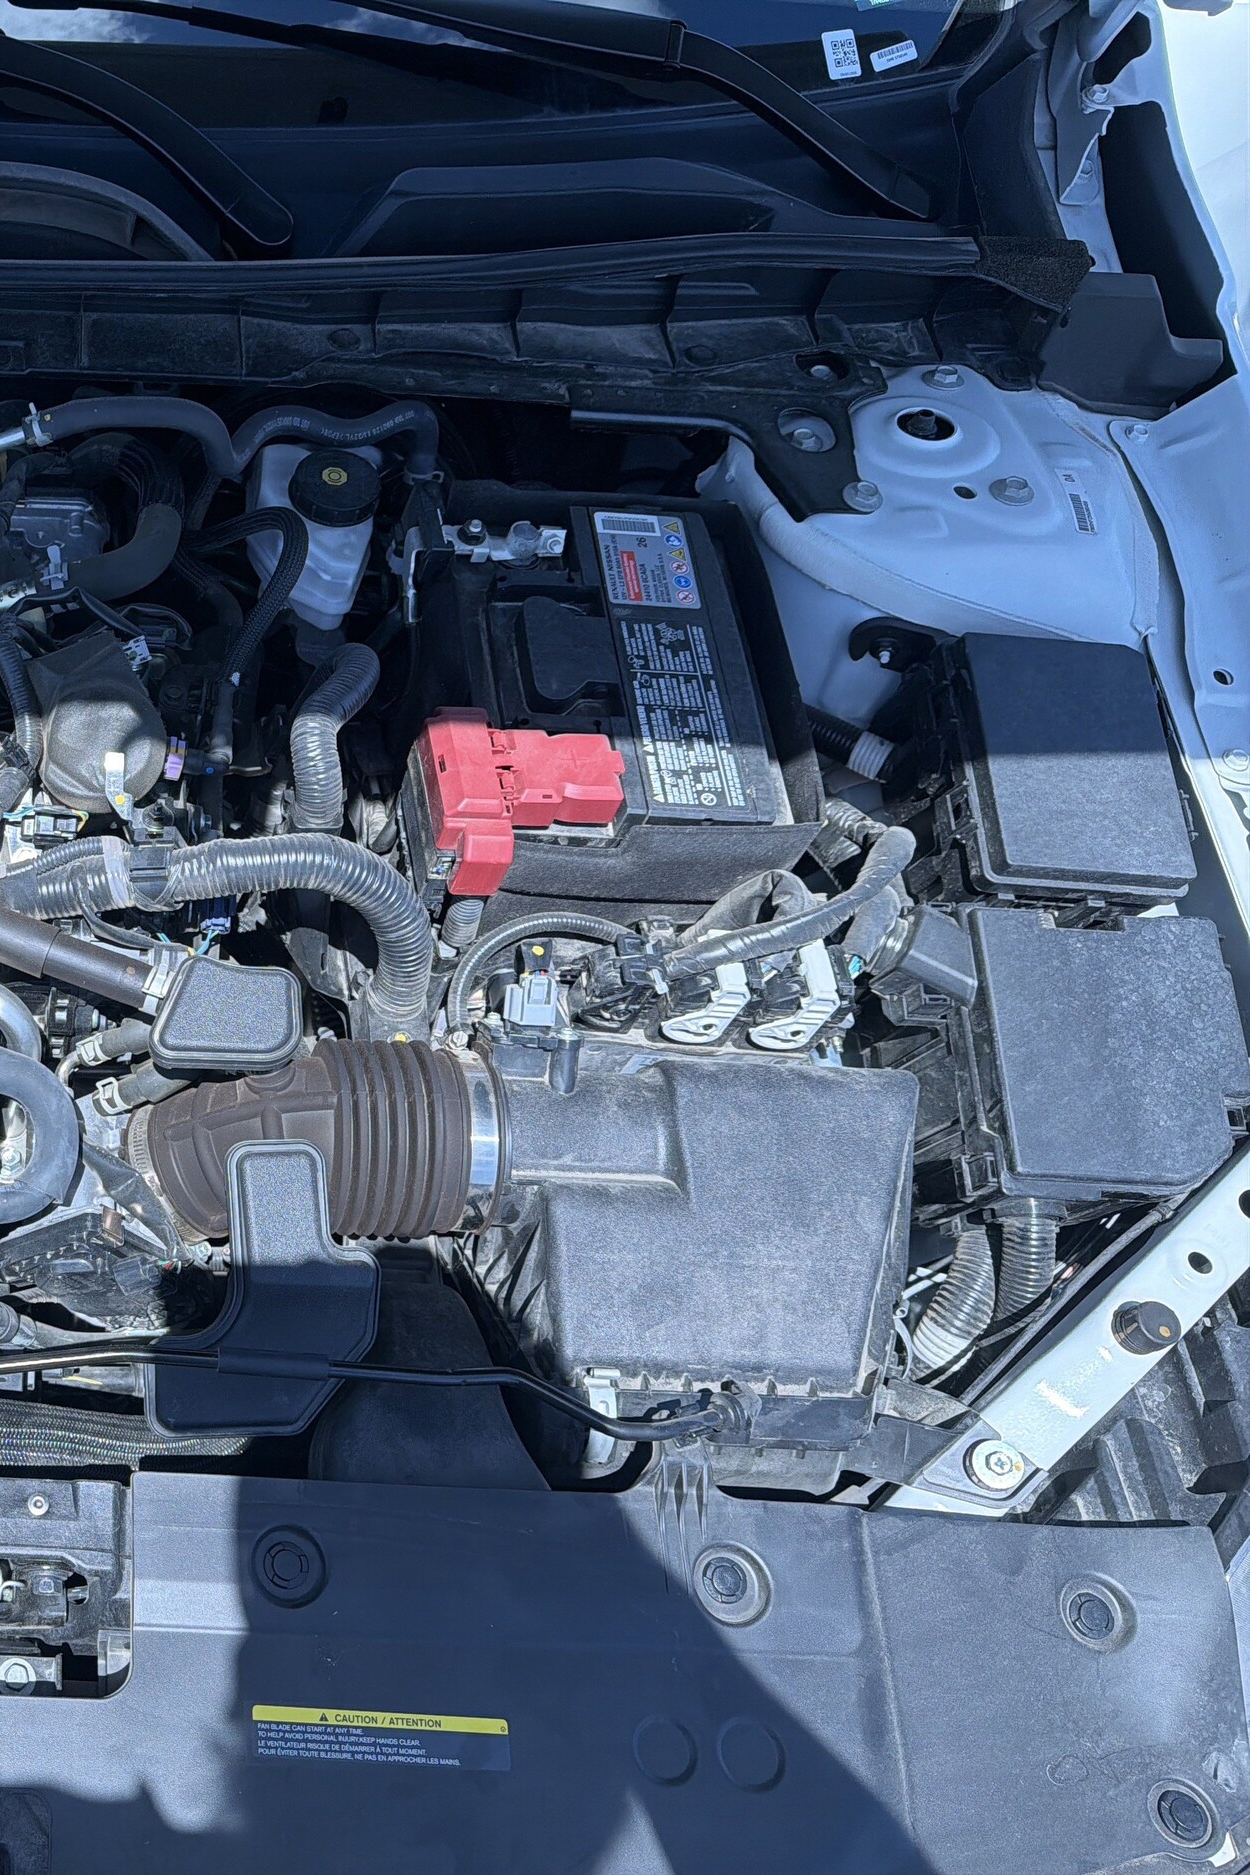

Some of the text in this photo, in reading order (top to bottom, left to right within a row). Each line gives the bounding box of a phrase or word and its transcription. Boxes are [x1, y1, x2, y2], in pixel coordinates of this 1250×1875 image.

[636, 536, 648, 548] 26
[603, 544, 619, 600] RENAULT NISSAN
[334, 1714, 442, 1728] CAUTION / ATTENTION
[307, 1725, 326, 1733] START
[267, 1731, 284, 1739] HELP
[304, 1734, 338, 1742] PERSONAL
[376, 1737, 398, 1745] HANDS
[266, 1740, 306, 1749] VENTILATEUR
[307, 1742, 331, 1751] RISQUE
[341, 1743, 375, 1752] DÉMARRER
[375, 1745, 381, 1753] À
[398, 1748, 427, 1756] MOMENT.
[277, 1747, 298, 1756] ÉVITER
[299, 1750, 320, 1758] TOUTE
[387, 1756, 426, 1764] APPROCHER
[426, 1757, 439, 1765] LES
[439, 1758, 461, 1766] MAINS.
